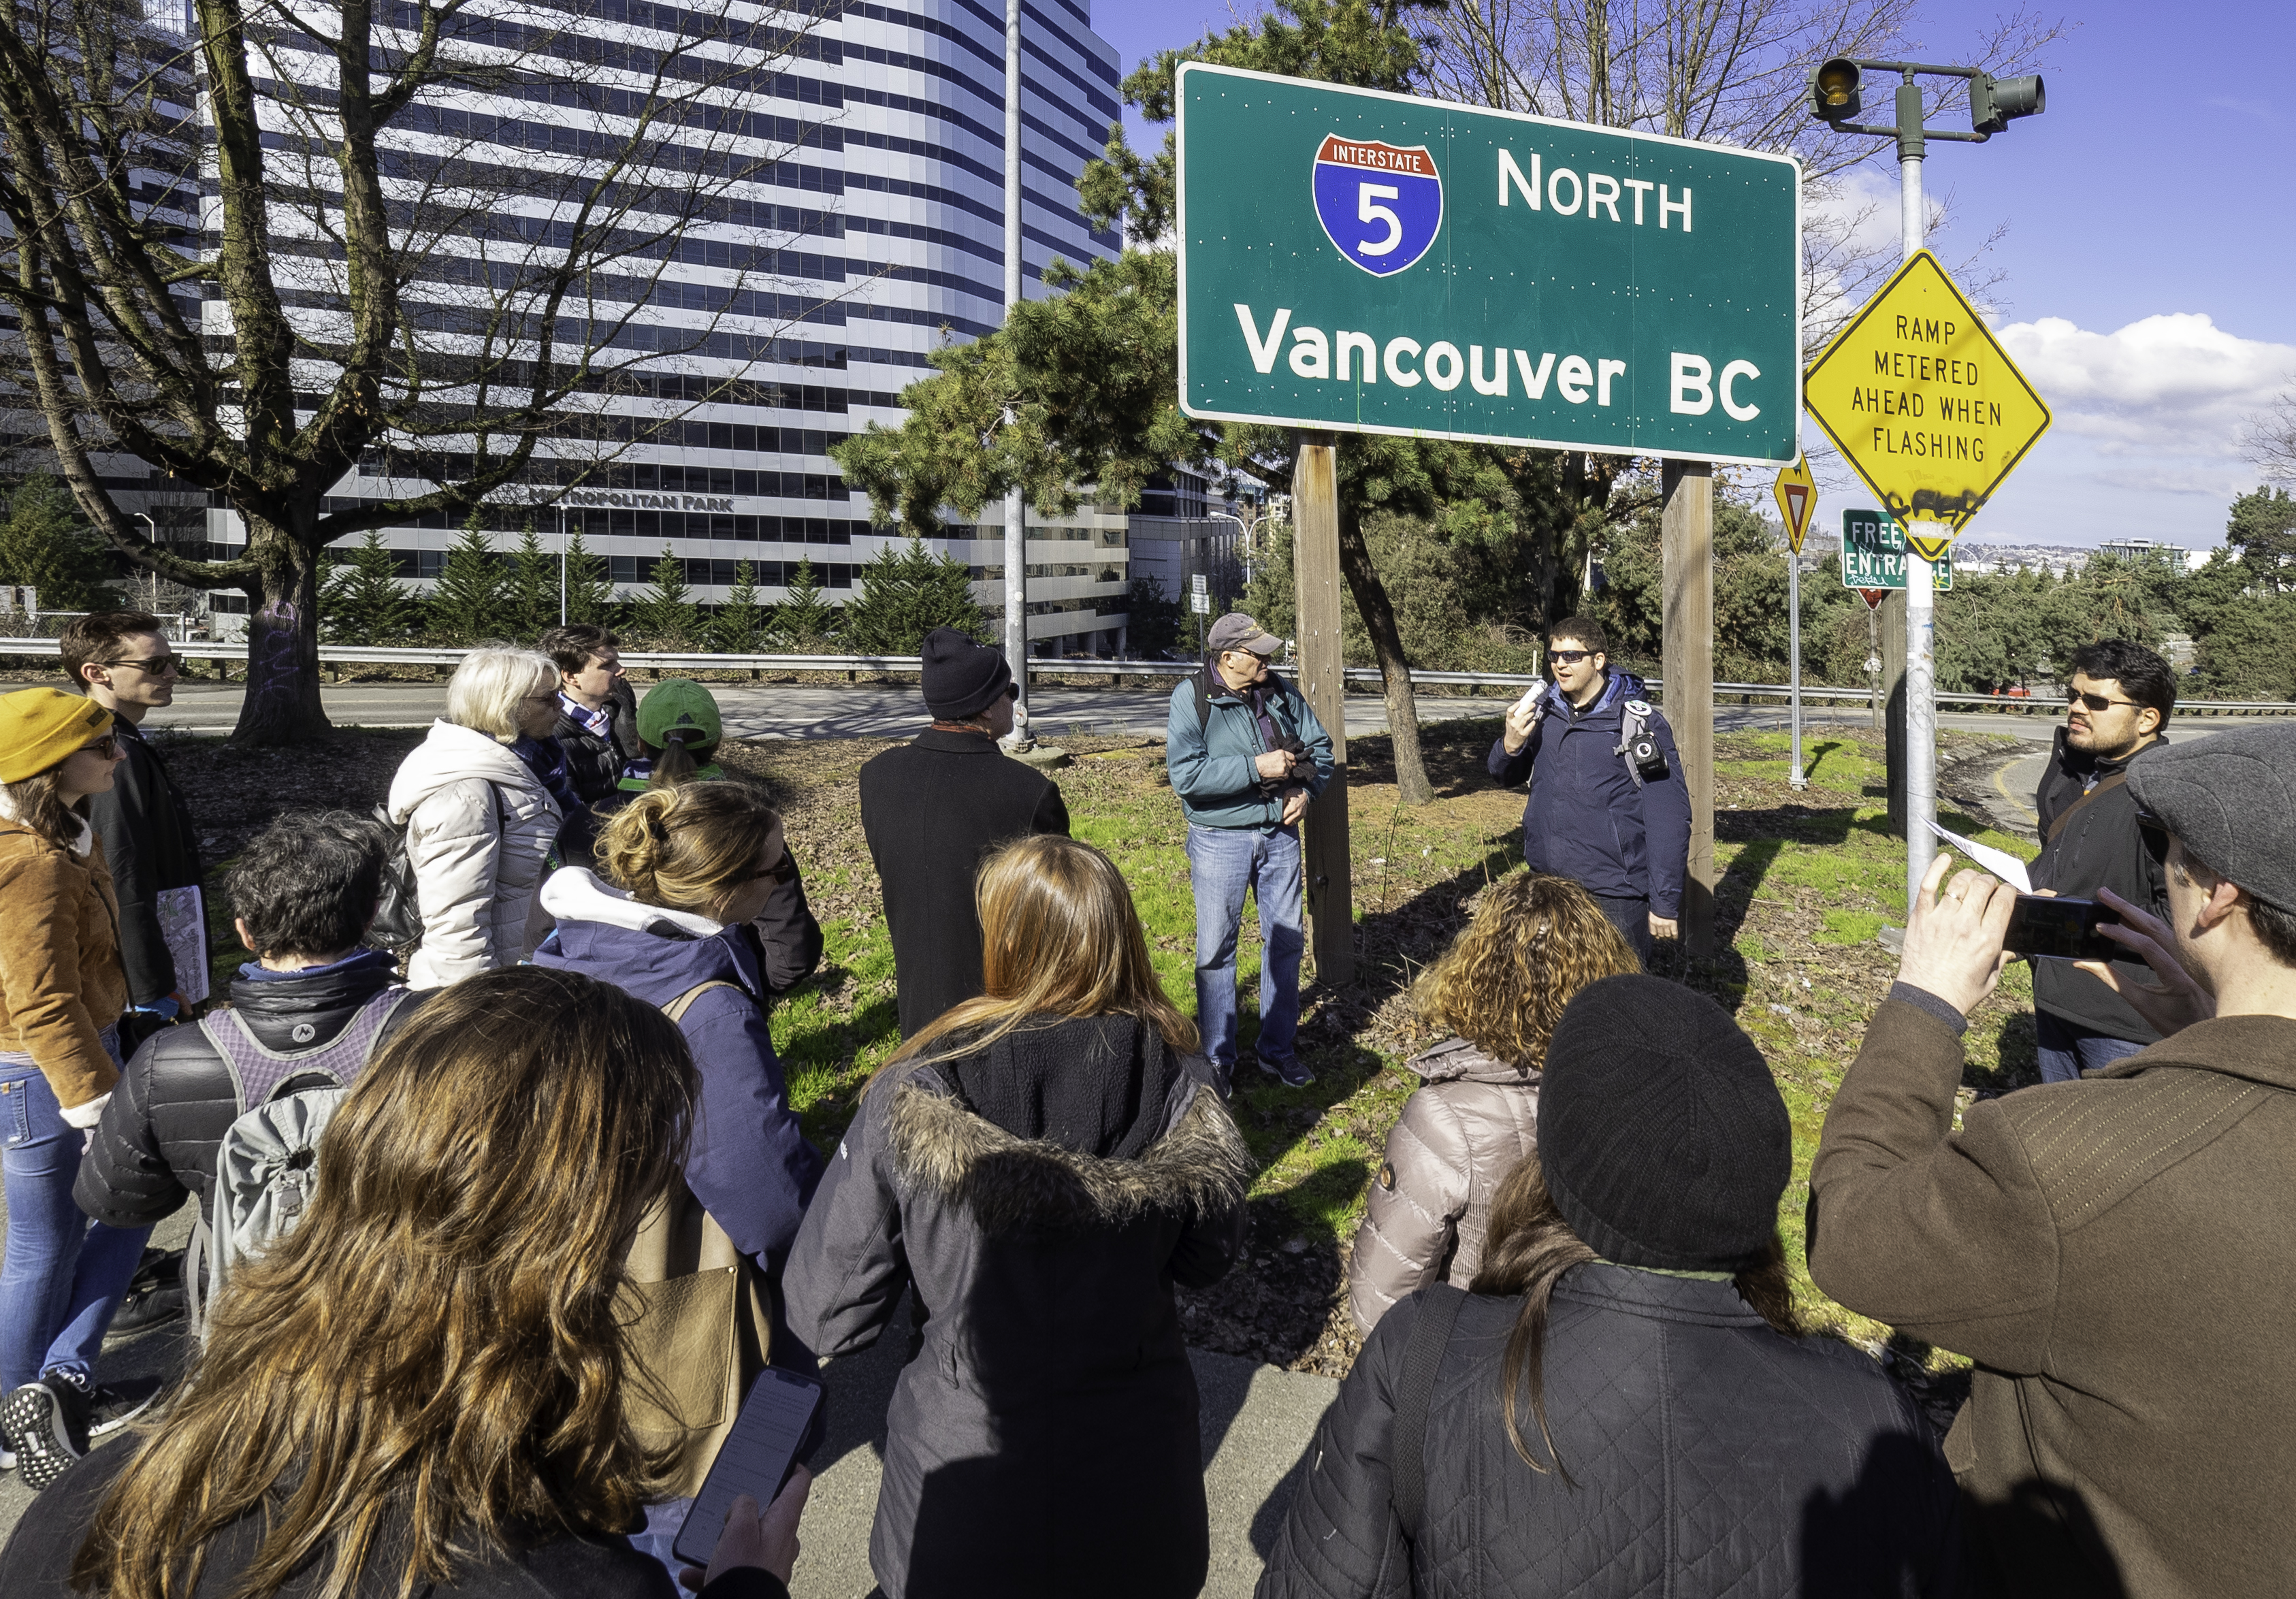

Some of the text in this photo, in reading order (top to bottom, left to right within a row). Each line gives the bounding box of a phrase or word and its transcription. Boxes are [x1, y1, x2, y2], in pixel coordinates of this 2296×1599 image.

[1333, 144, 1421, 172] INTERSTATE
[1498, 148, 1692, 233] NORTH
[1357, 182, 1403, 257] 5
[1896, 314, 1956, 345] RAMP
[1233, 303, 1762, 422] Vancouver BC
[1875, 350, 1978, 386] METERED
[1852, 386, 2001, 427] AHEAD WHEN
[1873, 427, 1984, 462] FLASHING
[682, 495, 734, 513] PARK
[1852, 521, 1902, 545] FREE
